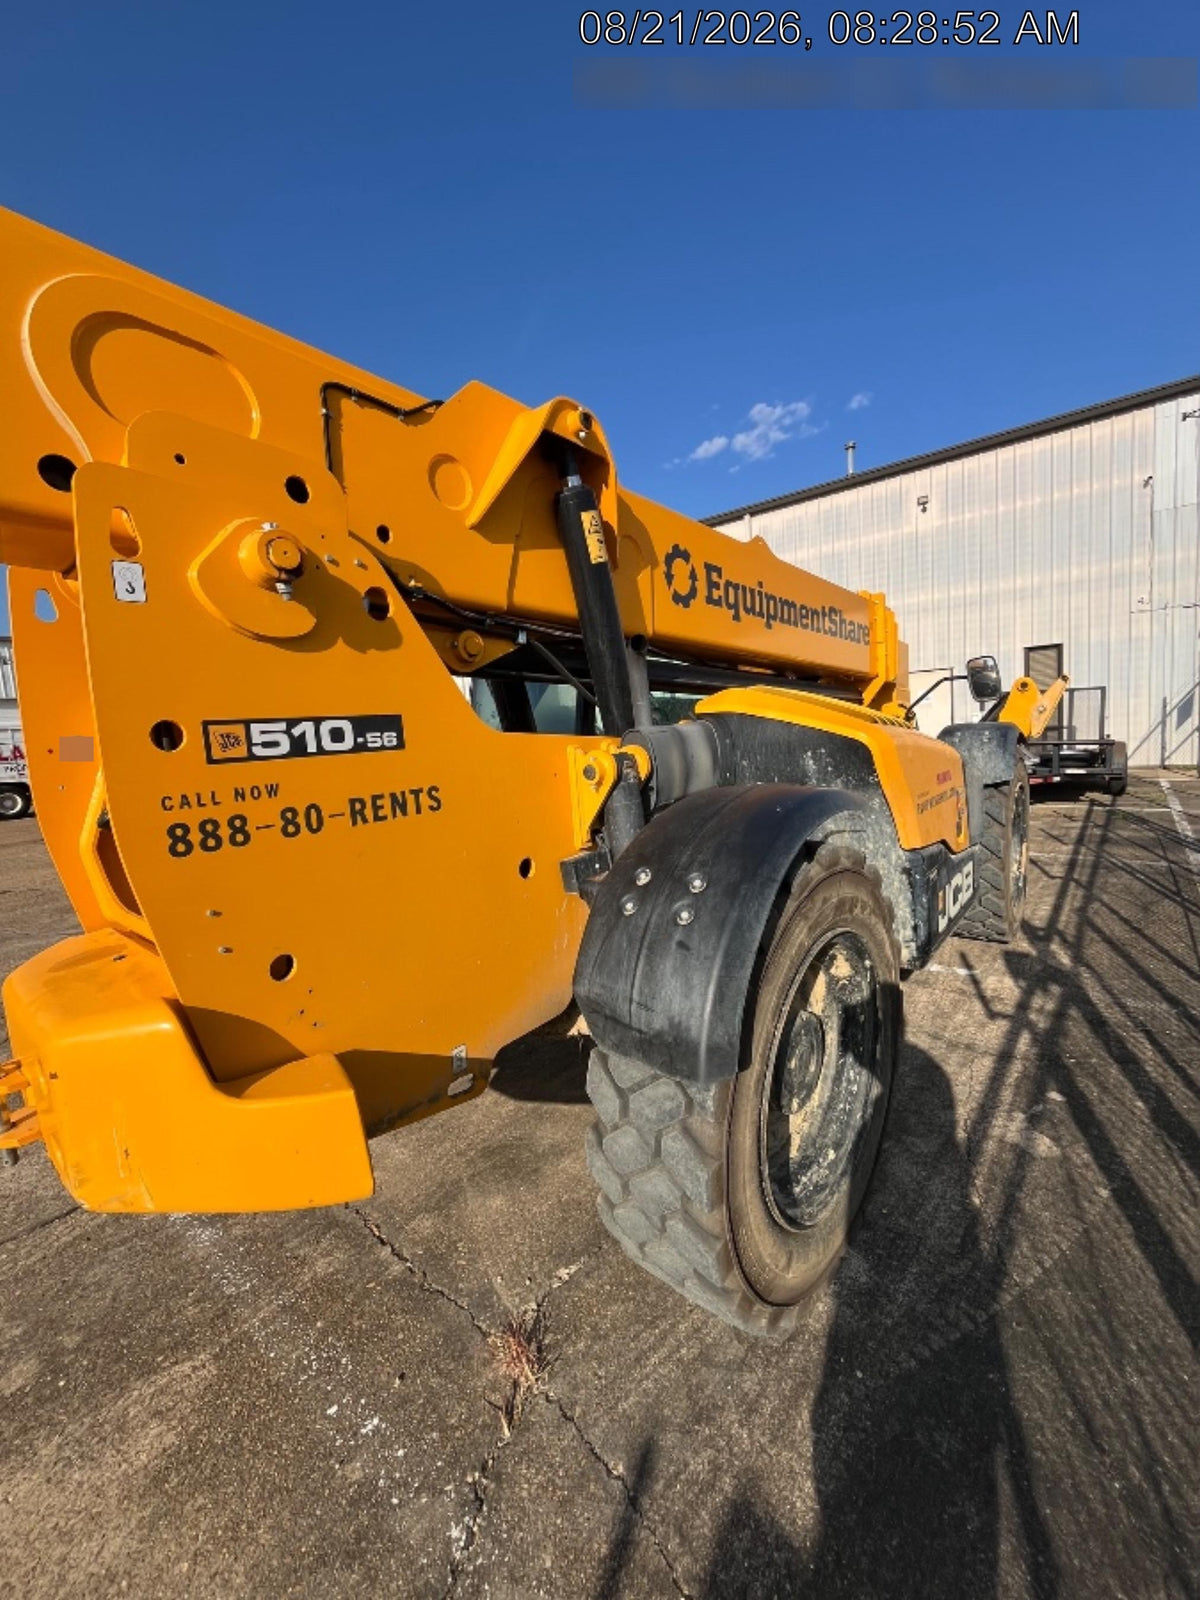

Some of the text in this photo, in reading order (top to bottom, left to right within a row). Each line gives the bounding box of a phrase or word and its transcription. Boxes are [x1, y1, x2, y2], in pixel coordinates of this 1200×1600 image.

[703, 561, 870, 646] EquipmentShare
[250, 720, 398, 756] 510-56
[161, 783, 280, 812] CALL NOW
[166, 785, 442, 858] 888-80-RENTS
[938, 860, 974, 933] JCB
